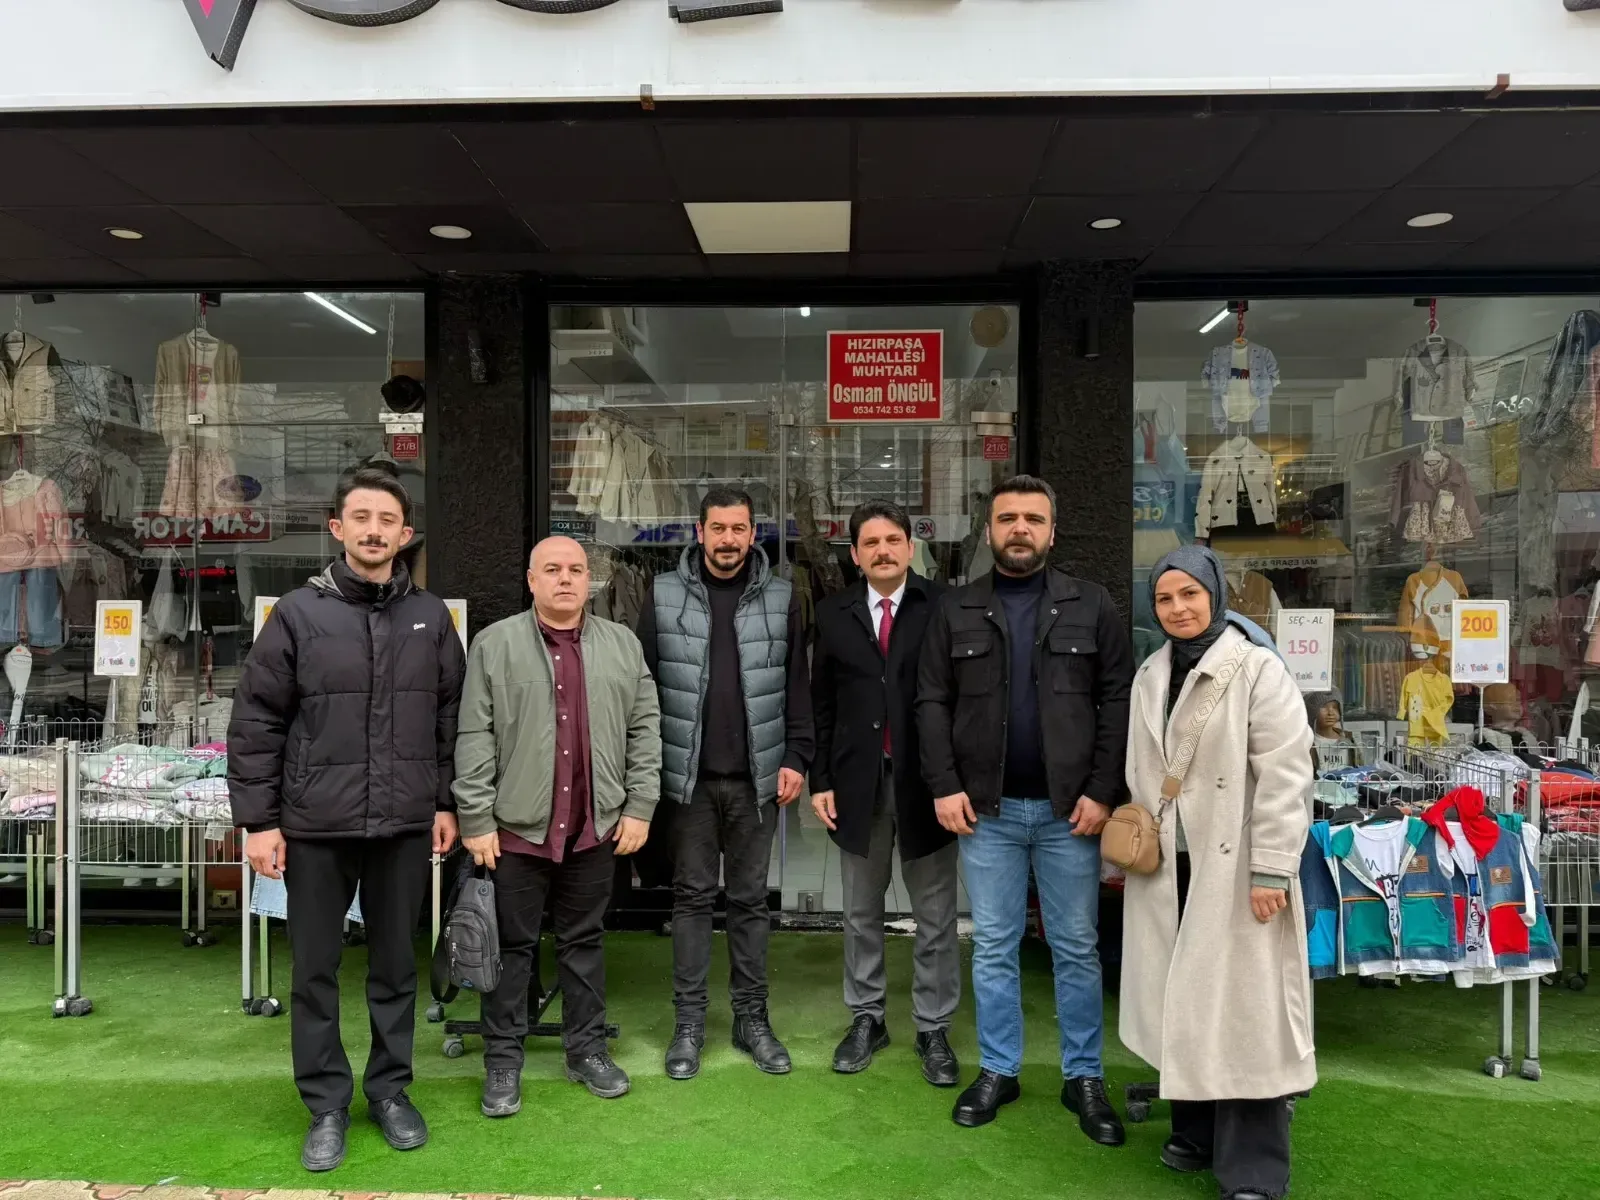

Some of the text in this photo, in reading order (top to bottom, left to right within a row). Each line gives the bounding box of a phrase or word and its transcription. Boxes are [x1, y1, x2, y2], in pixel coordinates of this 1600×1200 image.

[847, 338, 924, 351] HIZIRPAŞA
[844, 349, 926, 364] MAHALLESİ
[852, 365, 917, 377] MUHTARI
[833, 379, 937, 403] Osman ÖNGÜL
[853, 405, 917, 414] 0534 742 53 62
[396, 442, 417, 451] 21/B
[986, 443, 1007, 452] 21/C
[104, 615, 129, 630] 150
[1288, 616, 1305, 627] SEÇ
[1311, 616, 1324, 625] AL
[1461, 616, 1493, 633] 200
[1287, 639, 1319, 655] 150
